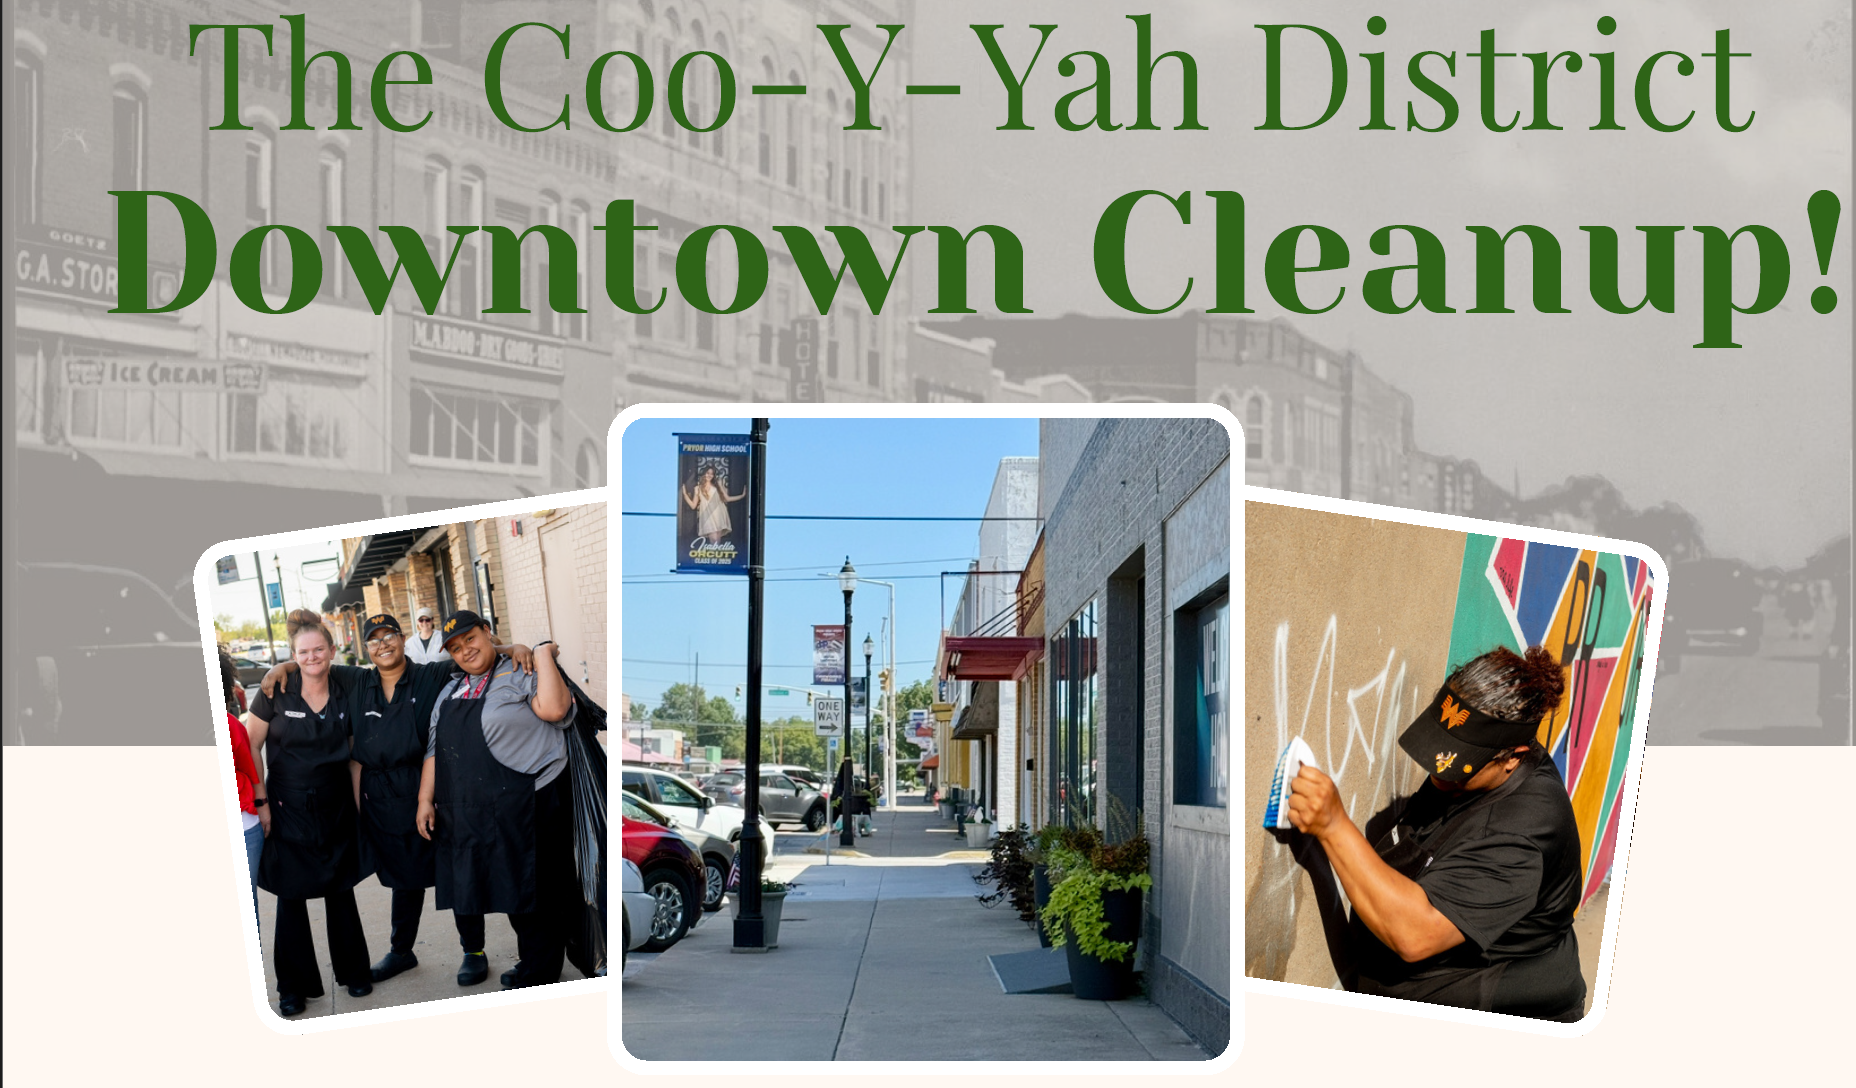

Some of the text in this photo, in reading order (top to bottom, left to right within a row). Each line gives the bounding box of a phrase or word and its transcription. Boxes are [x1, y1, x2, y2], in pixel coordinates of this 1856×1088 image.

[61, 257, 118, 297] STOR
[795, 322, 810, 400] HOTE
[111, 362, 141, 382] ICE
[147, 361, 217, 386] CREAM
[683, 444, 747, 453] PRYOR HIGH SCHOOL
[690, 536, 736, 552] Isabella
[689, 550, 738, 559] ORCUTT
[818, 701, 840, 711] ONE
[818, 712, 840, 721] WAY
